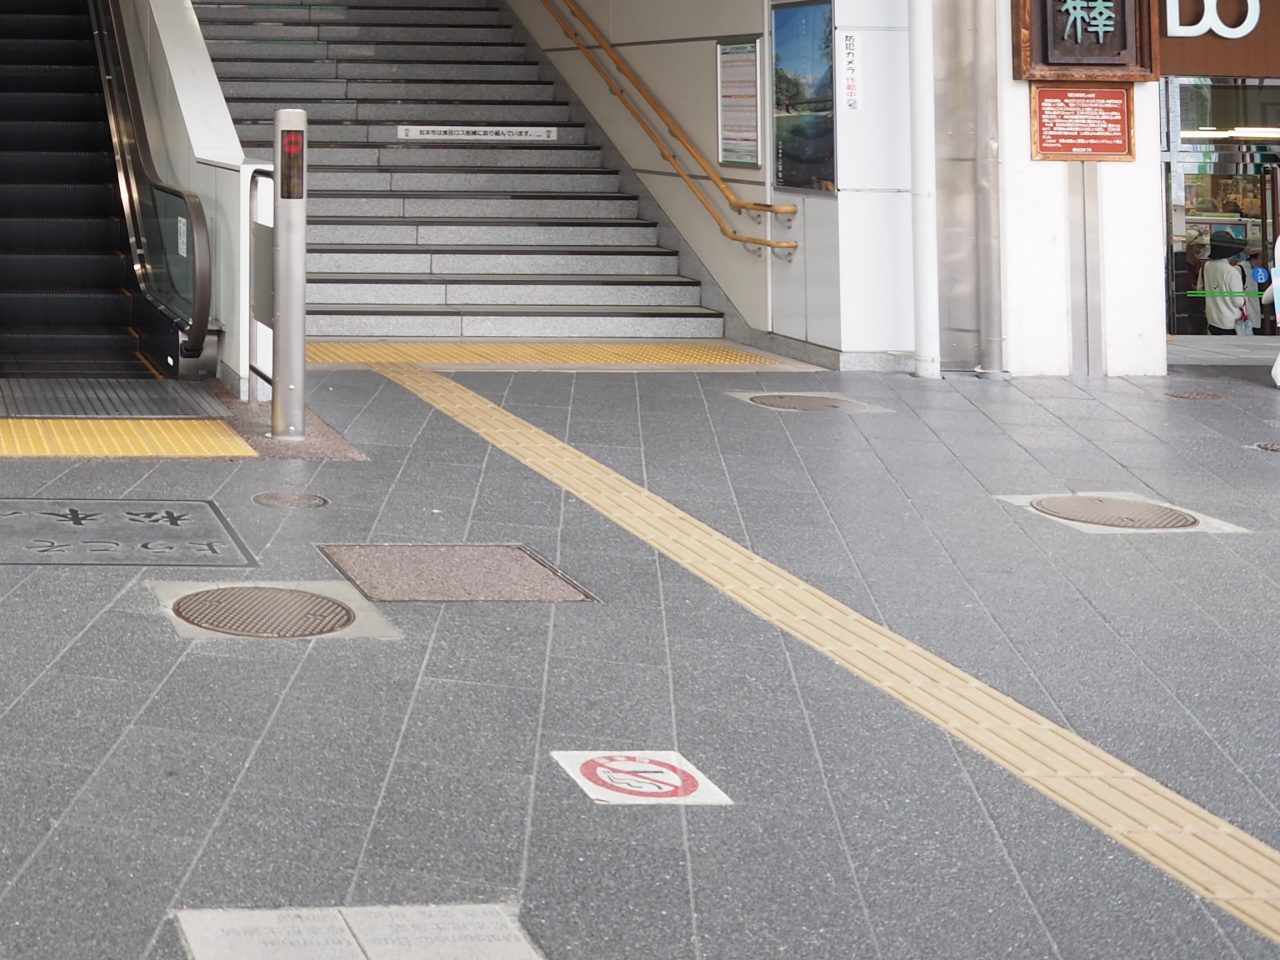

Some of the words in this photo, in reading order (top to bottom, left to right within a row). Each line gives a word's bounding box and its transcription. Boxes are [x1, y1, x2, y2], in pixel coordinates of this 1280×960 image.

[844, 34, 856, 74] 防犯カメラ
[25, 539, 226, 554] ようこそ
